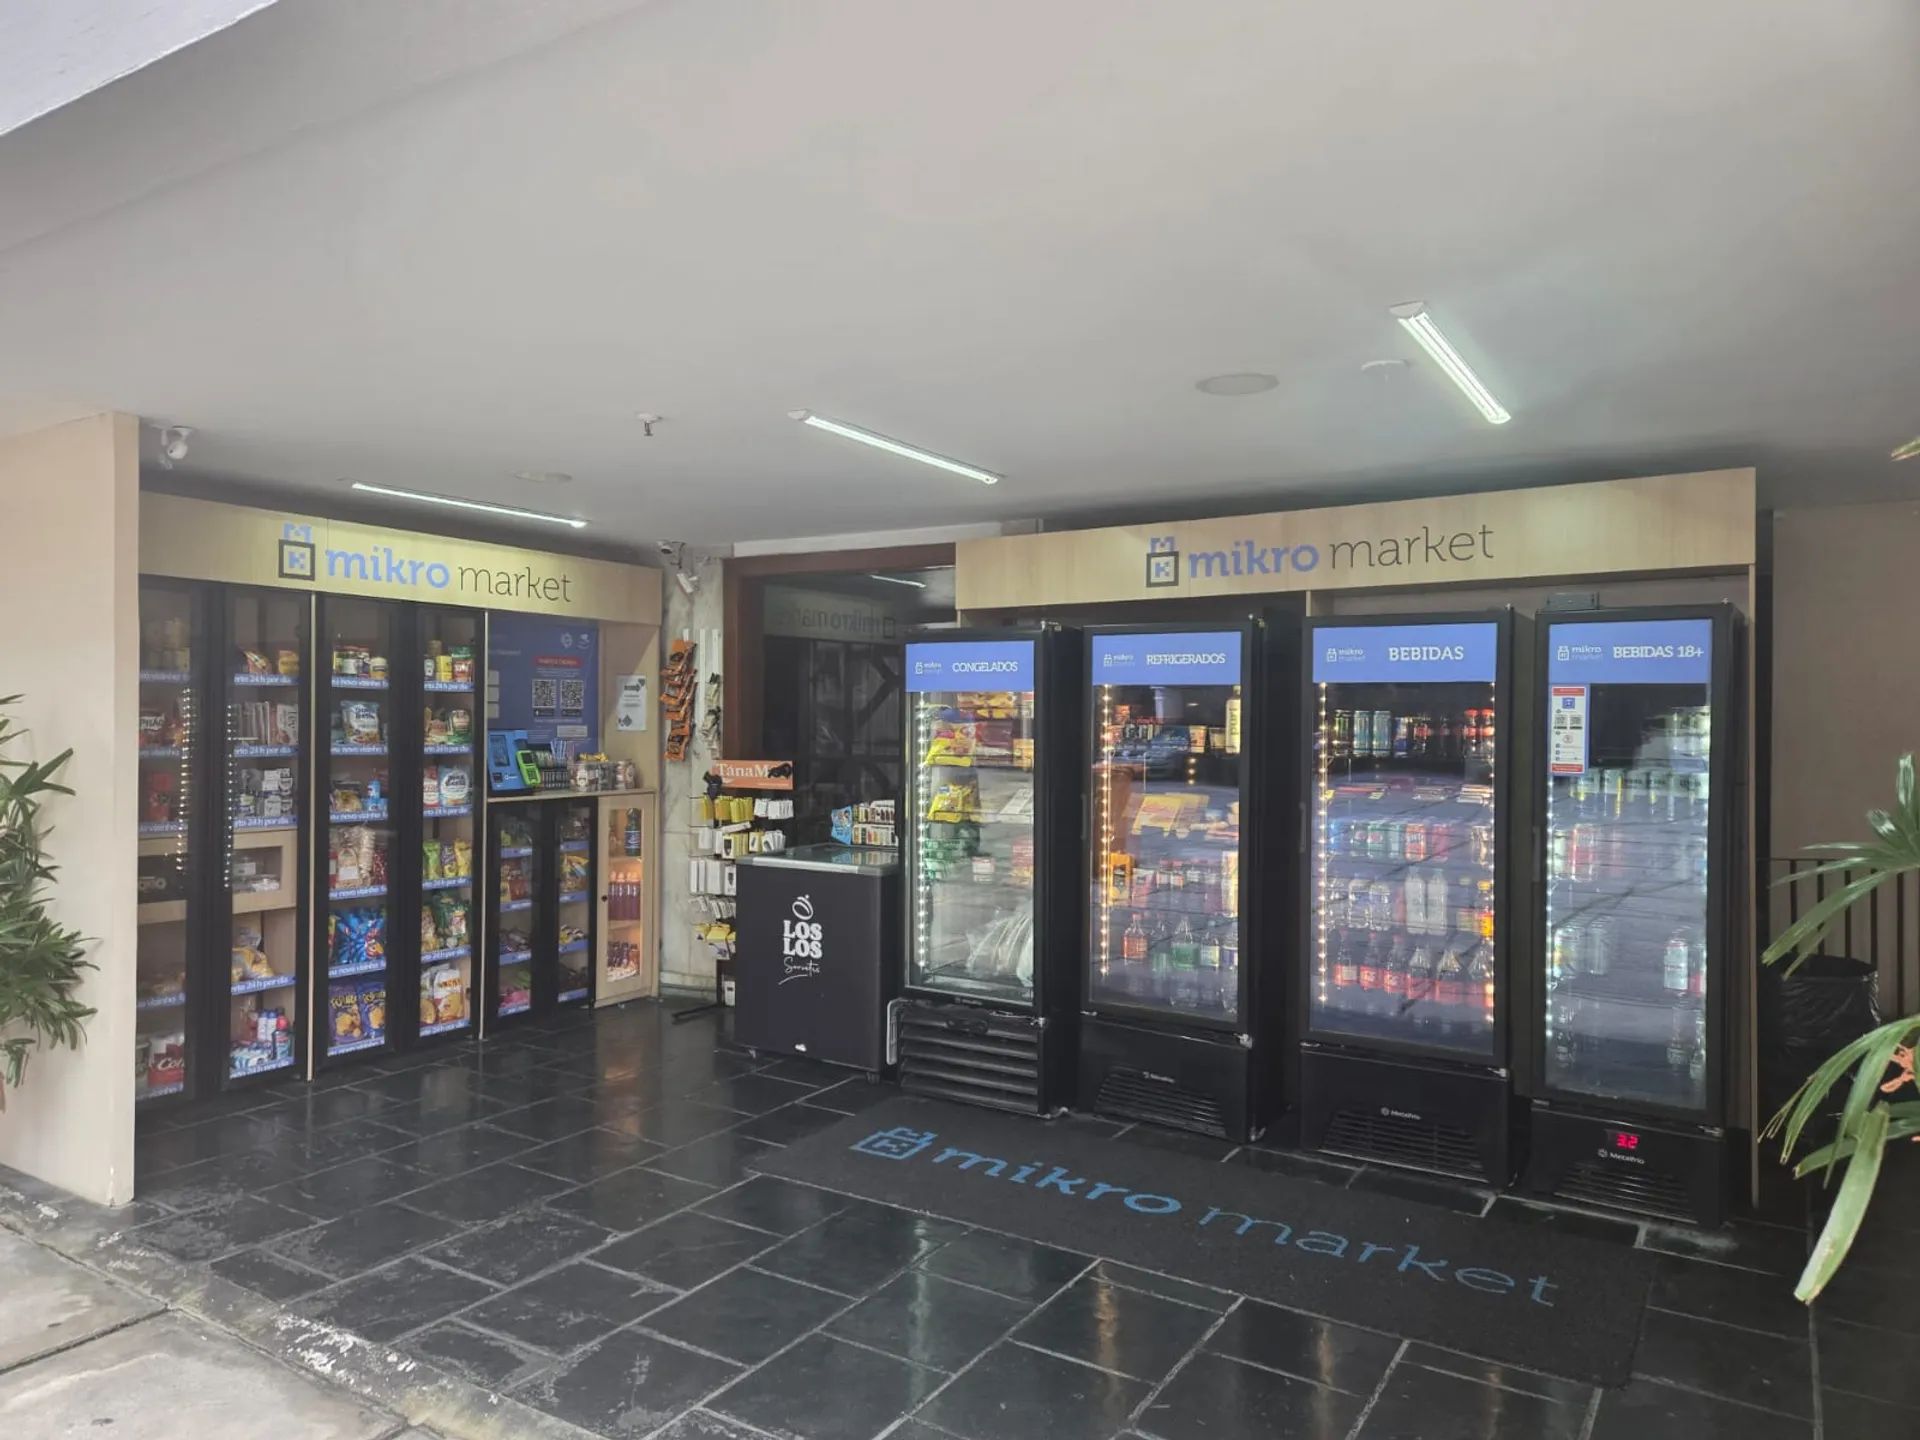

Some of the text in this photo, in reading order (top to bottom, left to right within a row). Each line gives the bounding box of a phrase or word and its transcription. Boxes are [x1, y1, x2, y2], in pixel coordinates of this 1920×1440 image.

[1188, 524, 1495, 578] mikro market
[325, 544, 572, 603] mikro market
[1146, 653, 1226, 664] REFRIGERADOS
[1388, 646, 1464, 661] BEBIDAS
[1613, 645, 1704, 658] BEBIDAS 18+
[953, 661, 1018, 672] CONGELADOS
[783, 920, 823, 941] LOS
[783, 937, 823, 959] LOS
[931, 1145, 1560, 1307] mikro market
